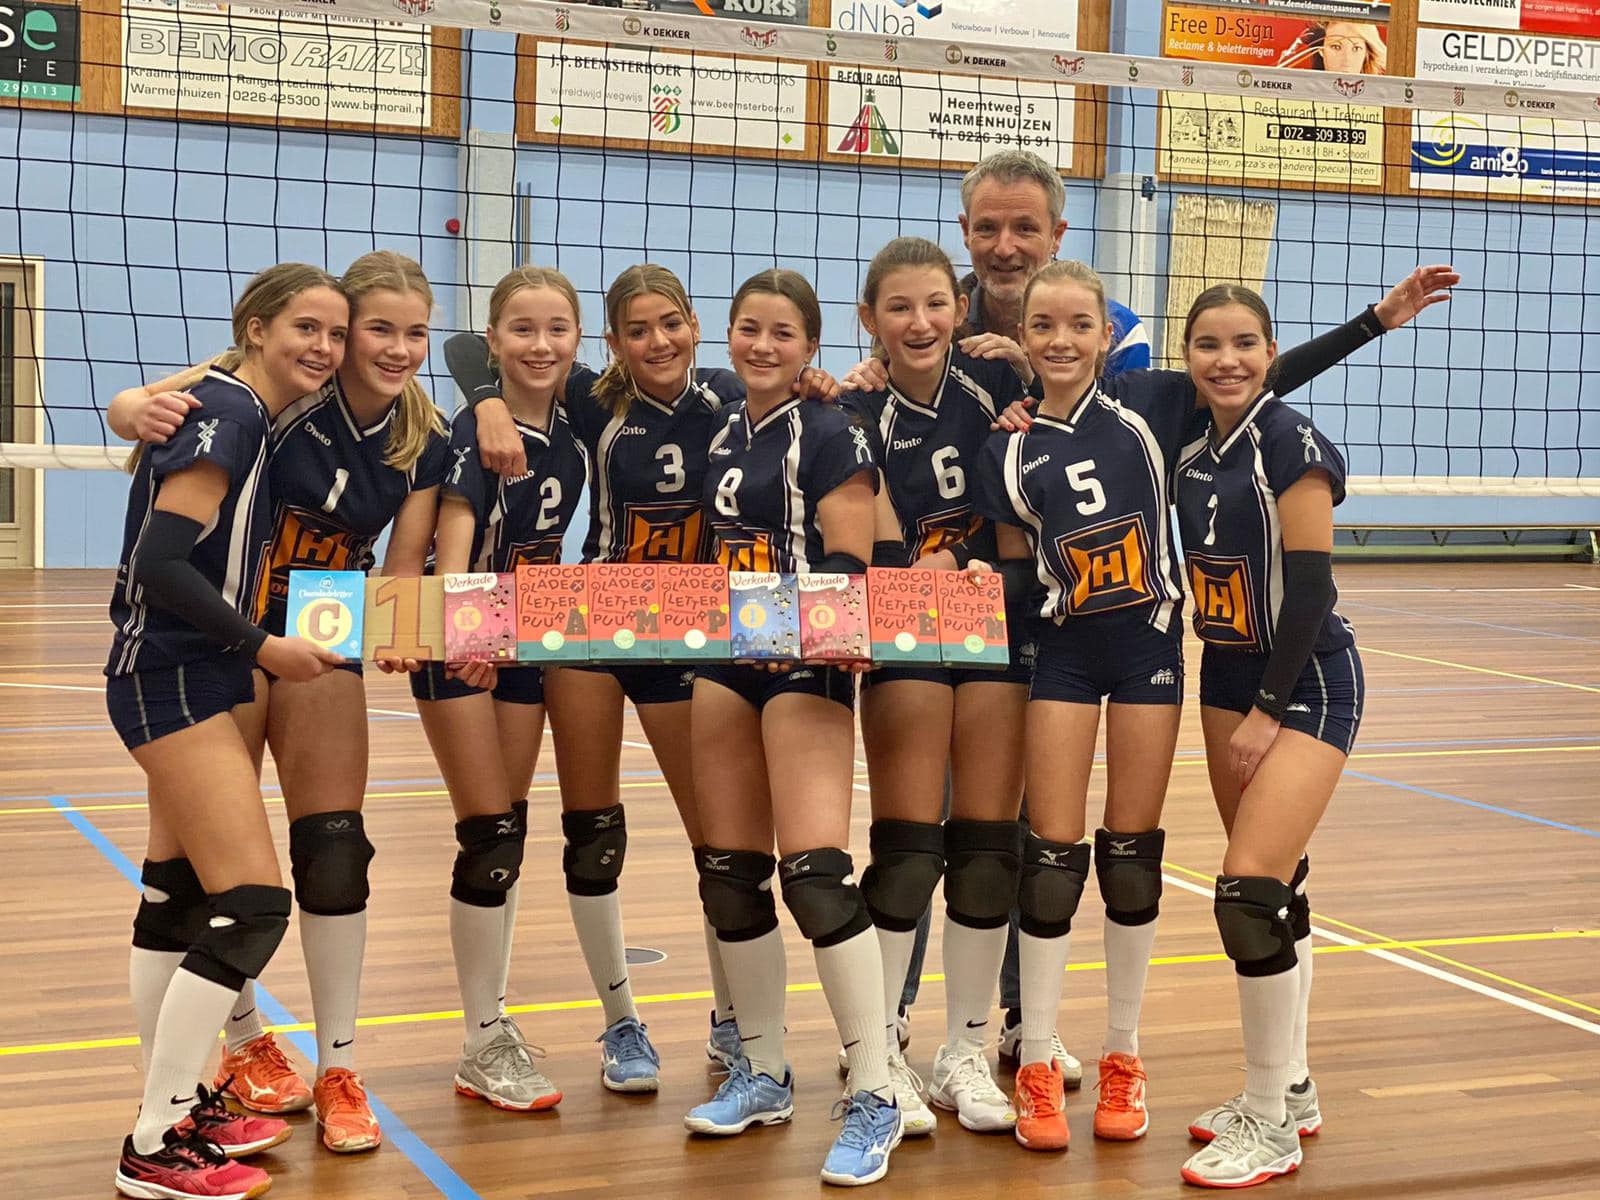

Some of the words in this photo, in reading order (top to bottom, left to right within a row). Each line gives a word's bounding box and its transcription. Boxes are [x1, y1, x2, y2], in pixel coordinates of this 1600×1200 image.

[643, 27, 650, 36] K
[653, 28, 690, 39] DEKKER
[951, 22, 992, 33] Nieuwbouw
[1000, 26, 1030, 37] Verbouw
[1037, 29, 1070, 40] Renovatie
[1170, 13, 1208, 34] Free
[1215, 17, 1274, 43] D-Sign
[129, 27, 287, 65] BEMO
[292, 41, 396, 74] RAIL
[1169, 39, 1204, 51] Reclame
[1207, 41, 1214, 52] &
[1217, 42, 1274, 58] beletteringen
[1442, 33, 1600, 69] GELDXPERT
[575, 56, 681, 76] BEEMSTERBOER
[964, 55, 971, 64] K
[973, 56, 1006, 68] DEKKER
[1423, 61, 1468, 73] hypotheken
[1476, 66, 1528, 78] verzekeringen
[1253, 79, 1259, 88] K
[1261, 80, 1292, 90] DEKKER
[130, 83, 221, 99] Warmenhuizen
[233, 90, 320, 106] 0226-425300
[331, 99, 425, 114] www.bemorail.n
[551, 87, 602, 99] wereldwijd
[605, 91, 643, 103] wegwijs
[690, 99, 794, 114] www.beemsterboer.nl
[947, 97, 1020, 116] Heemtweg
[1027, 103, 1035, 114] 5
[1519, 100, 1525, 108] K
[1527, 101, 1555, 110] DEKKER
[1254, 101, 1315, 118] Resauran
[929, 112, 1051, 131] WARMENHUZEN
[958, 130, 990, 143] 0226
[995, 133, 1010, 145] 39
[1035, 136, 1050, 147] 91
[1283, 127, 1304, 140] 072
[1336, 130, 1349, 142] 33
[1351, 131, 1365, 144] 99
[1255, 143, 1287, 156] Laanwg
[1343, 149, 1369, 159] Shoorl
[1235, 158, 1266, 171] pzza's
[1282, 162, 1314, 172] andere
[1317, 164, 1375, 176] specialieiten
[892, 436, 923, 451] Dinto
[655, 443, 686, 494] 3
[931, 445, 965, 500] 6
[1021, 453, 1050, 475] Dinto
[506, 469, 535, 486] Dino
[1186, 467, 1214, 483] Dinto
[321, 468, 350, 513] 1
[715, 467, 743, 517] 8
[1064, 459, 1107, 516] 5
[535, 476, 562, 531] 2
[526, 566, 585, 578] CHOCO
[598, 566, 655, 578] CHOCO
[668, 566, 725, 578] CHOCO
[877, 570, 932, 583] CHOCO
[1093, 549, 1124, 587] H
[446, 574, 493, 590] Verkade
[530, 579, 569, 593] LADE
[602, 578, 640, 592] LADE
[672, 578, 711, 592] LADE
[731, 573, 777, 587] Verkade
[800, 574, 846, 588] Verkade
[882, 582, 918, 595] LADE
[950, 585, 987, 599] LADE
[526, 594, 578, 611] LETTER
[598, 594, 648, 610] LETTER
[668, 594, 719, 610] LETTER
[878, 597, 927, 614] LETTER
[947, 600, 996, 617] LETTER
[1209, 584, 1231, 619] H
[308, 603, 341, 642] C
[374, 576, 432, 661] 1
[521, 611, 566, 628] PUUR
[564, 608, 588, 635] A
[593, 611, 637, 627] PUUR
[635, 608, 659, 634] M
[664, 611, 708, 627] PUUR
[706, 609, 727, 634] P
[875, 613, 916, 630] PUUR
[944, 616, 985, 632] PUUR
